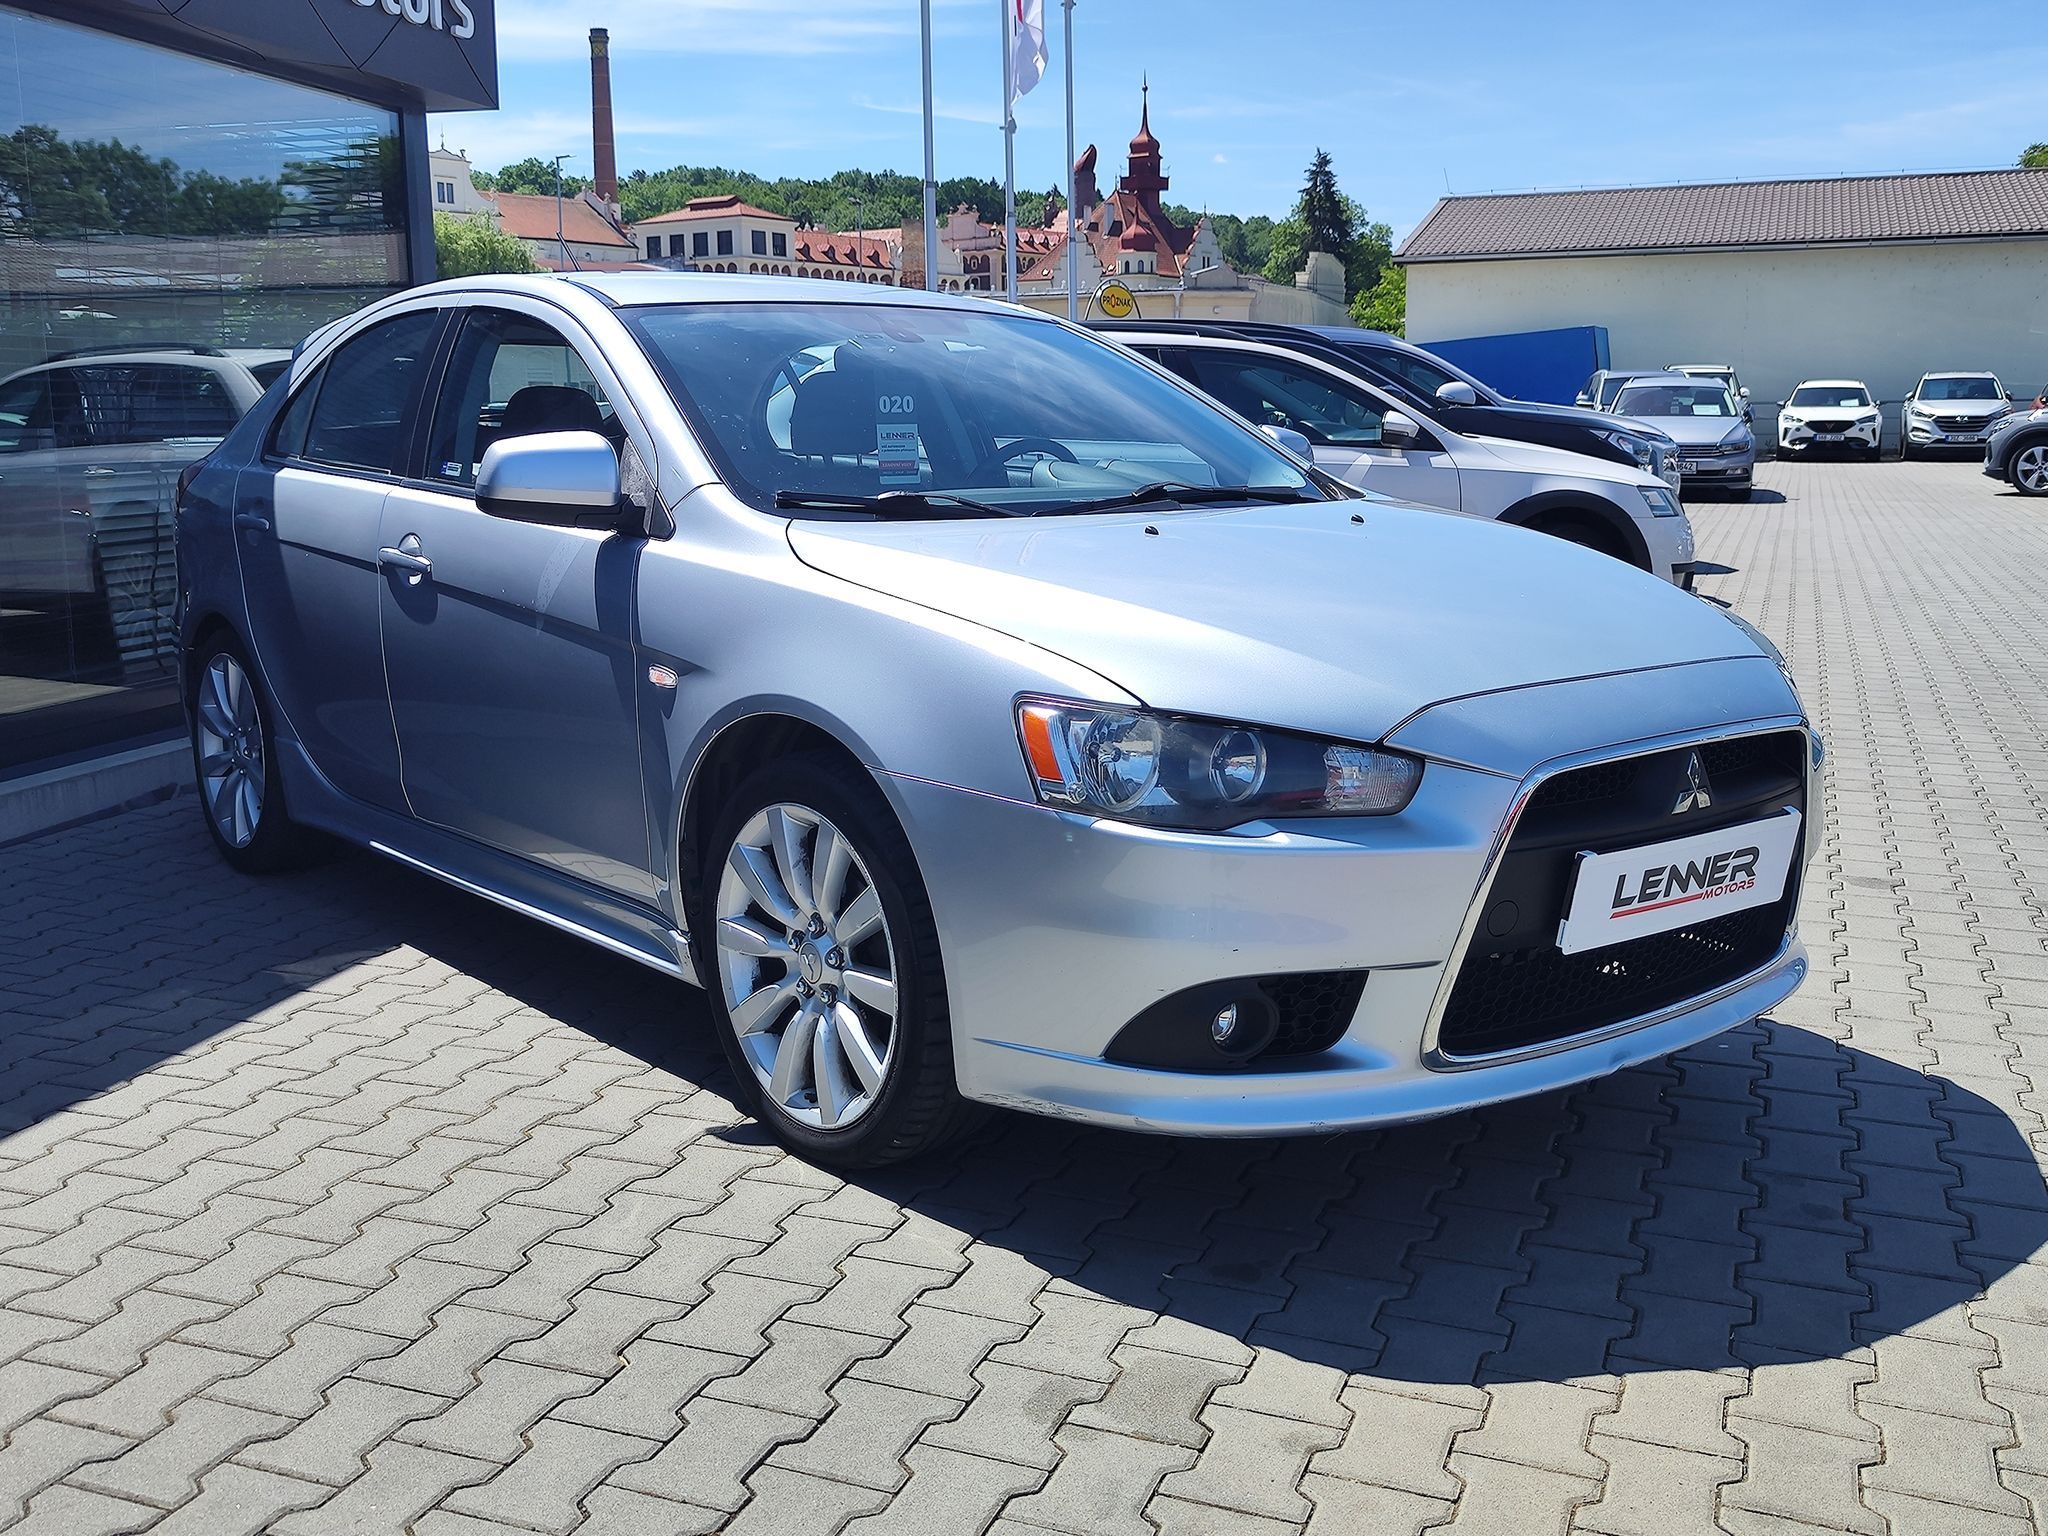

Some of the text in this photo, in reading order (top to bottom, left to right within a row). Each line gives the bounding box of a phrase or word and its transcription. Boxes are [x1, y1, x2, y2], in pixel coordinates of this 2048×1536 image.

[879, 395, 914, 414] 020
[1611, 846, 1760, 909] LENNER
[1702, 878, 1755, 900] MOTORS
